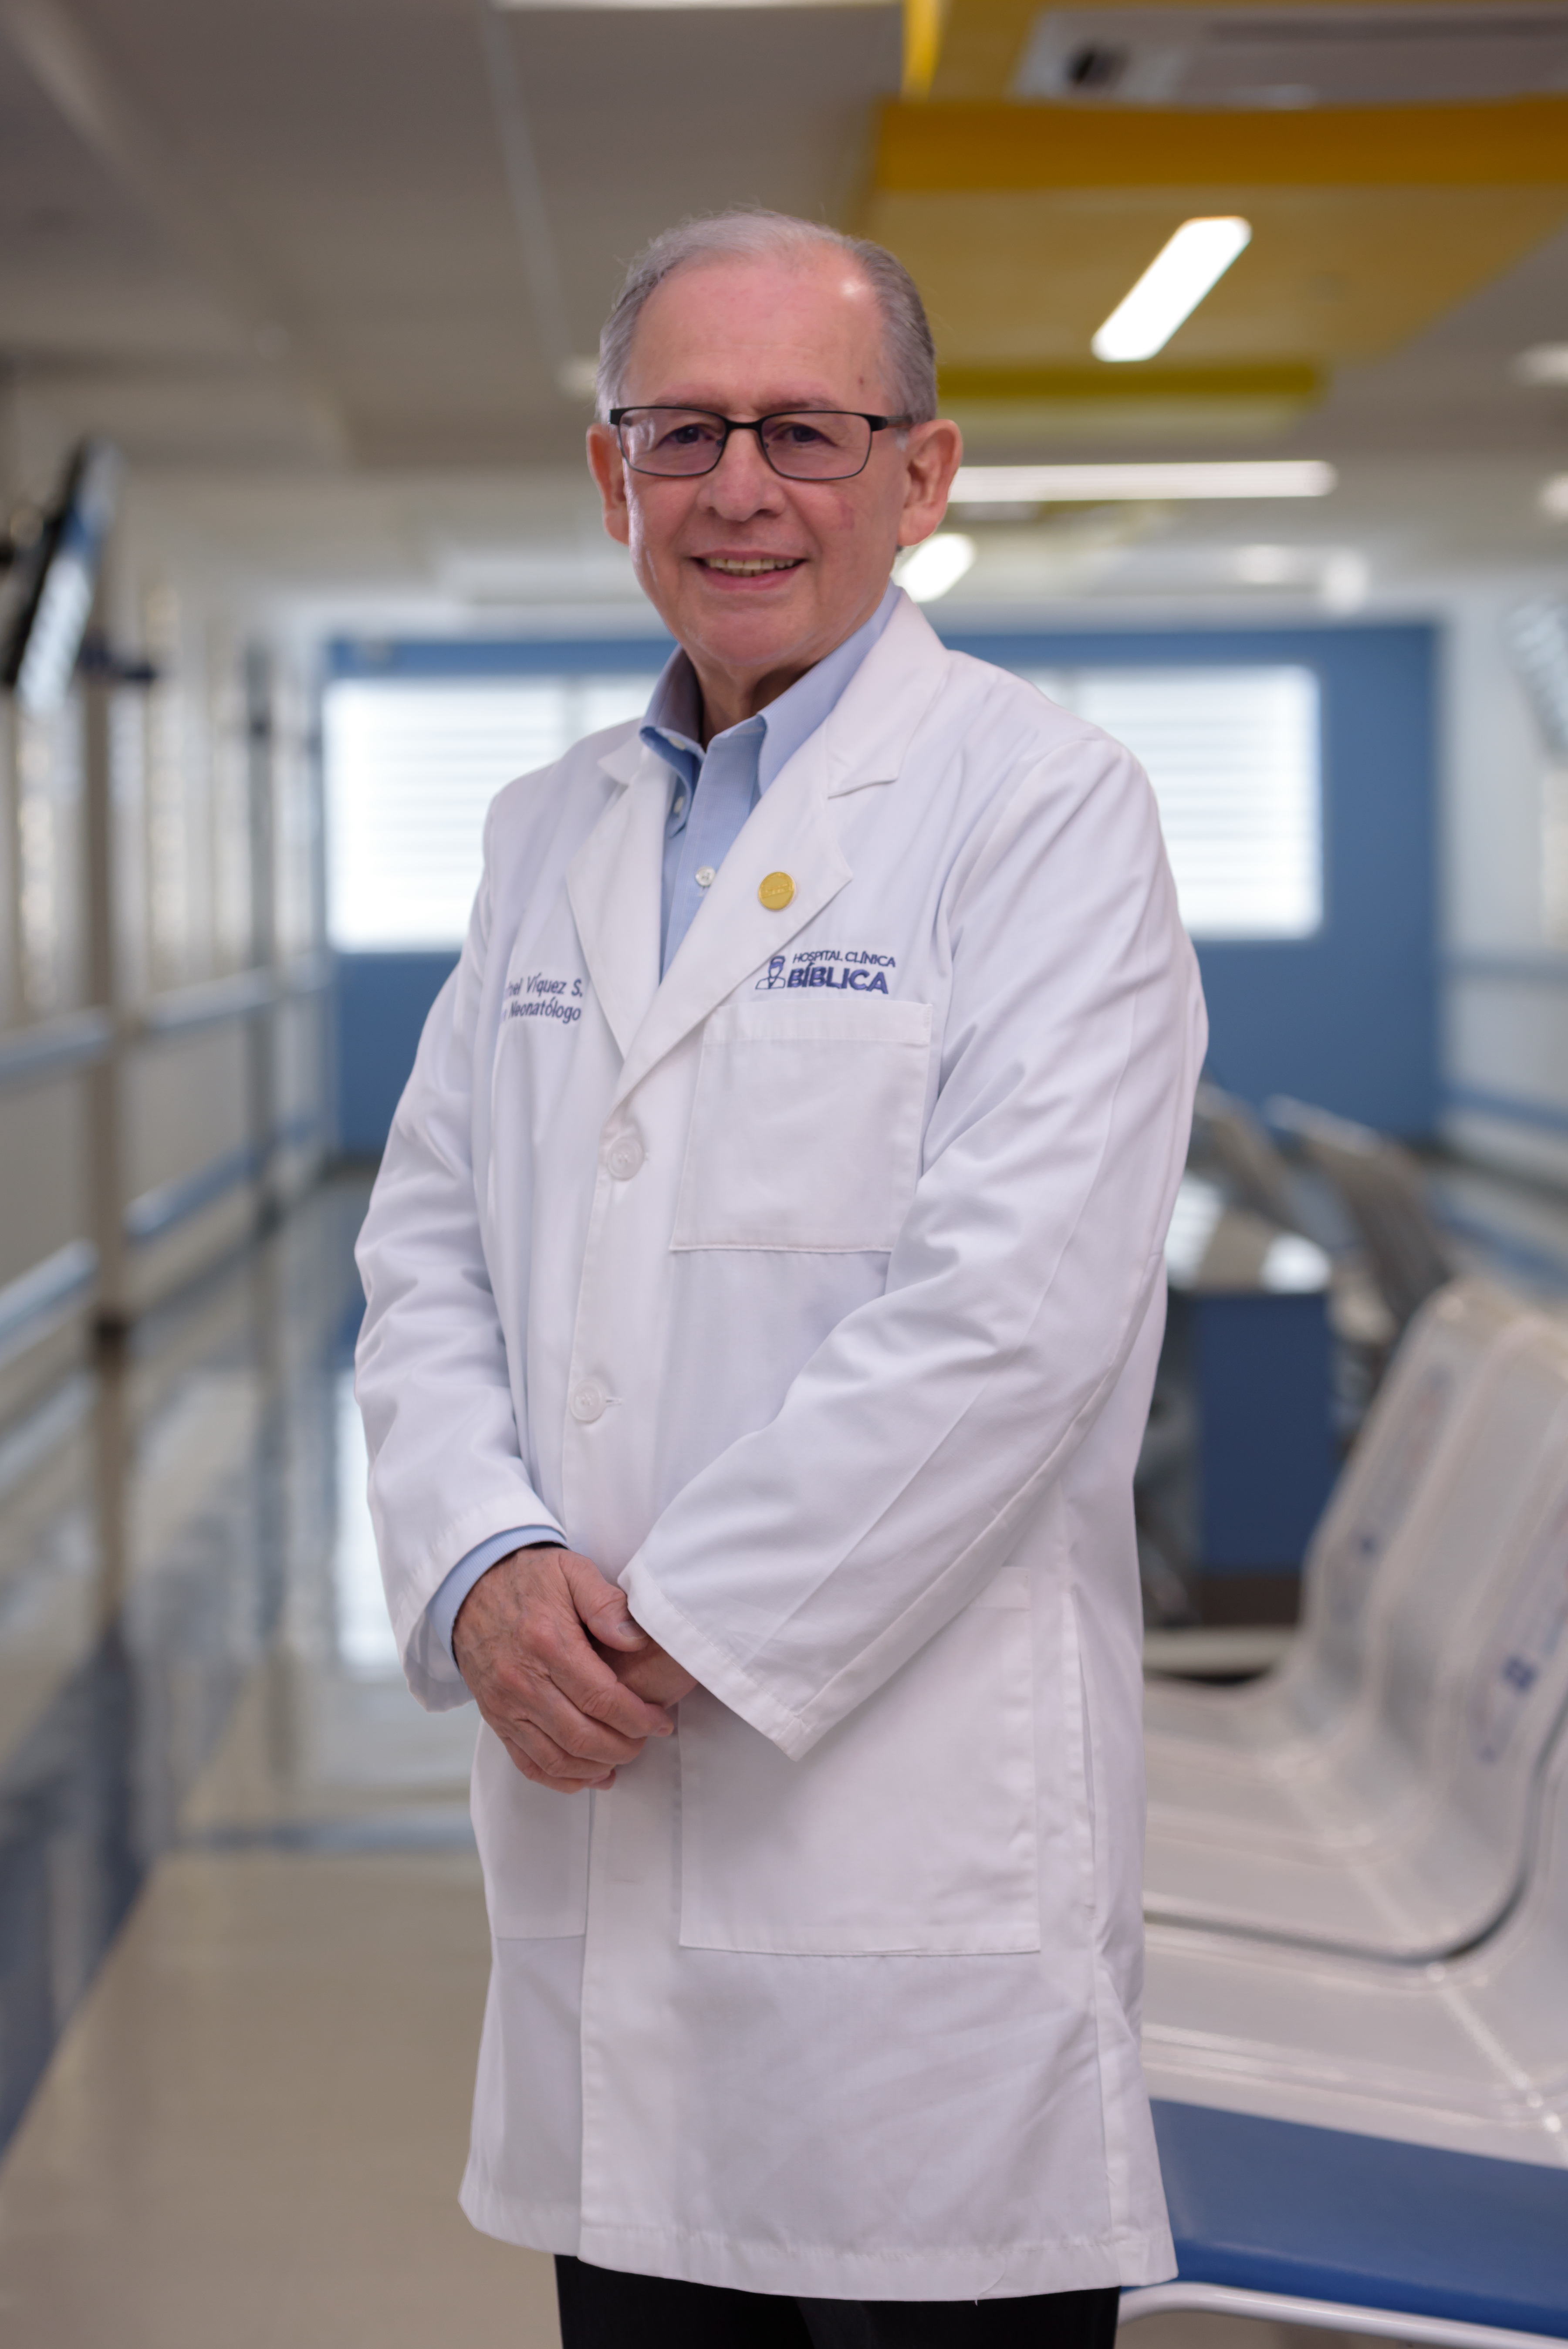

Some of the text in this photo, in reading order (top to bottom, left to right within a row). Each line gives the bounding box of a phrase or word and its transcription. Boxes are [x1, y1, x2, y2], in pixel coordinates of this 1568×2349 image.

[793, 950, 896, 967] HOSPITAL CLÍNICA
[526, 972, 567, 997] Víquez
[571, 978, 583, 998] S.
[787, 961, 889, 994] BÍBLICA
[508, 996, 582, 1024] Neonatólogo
